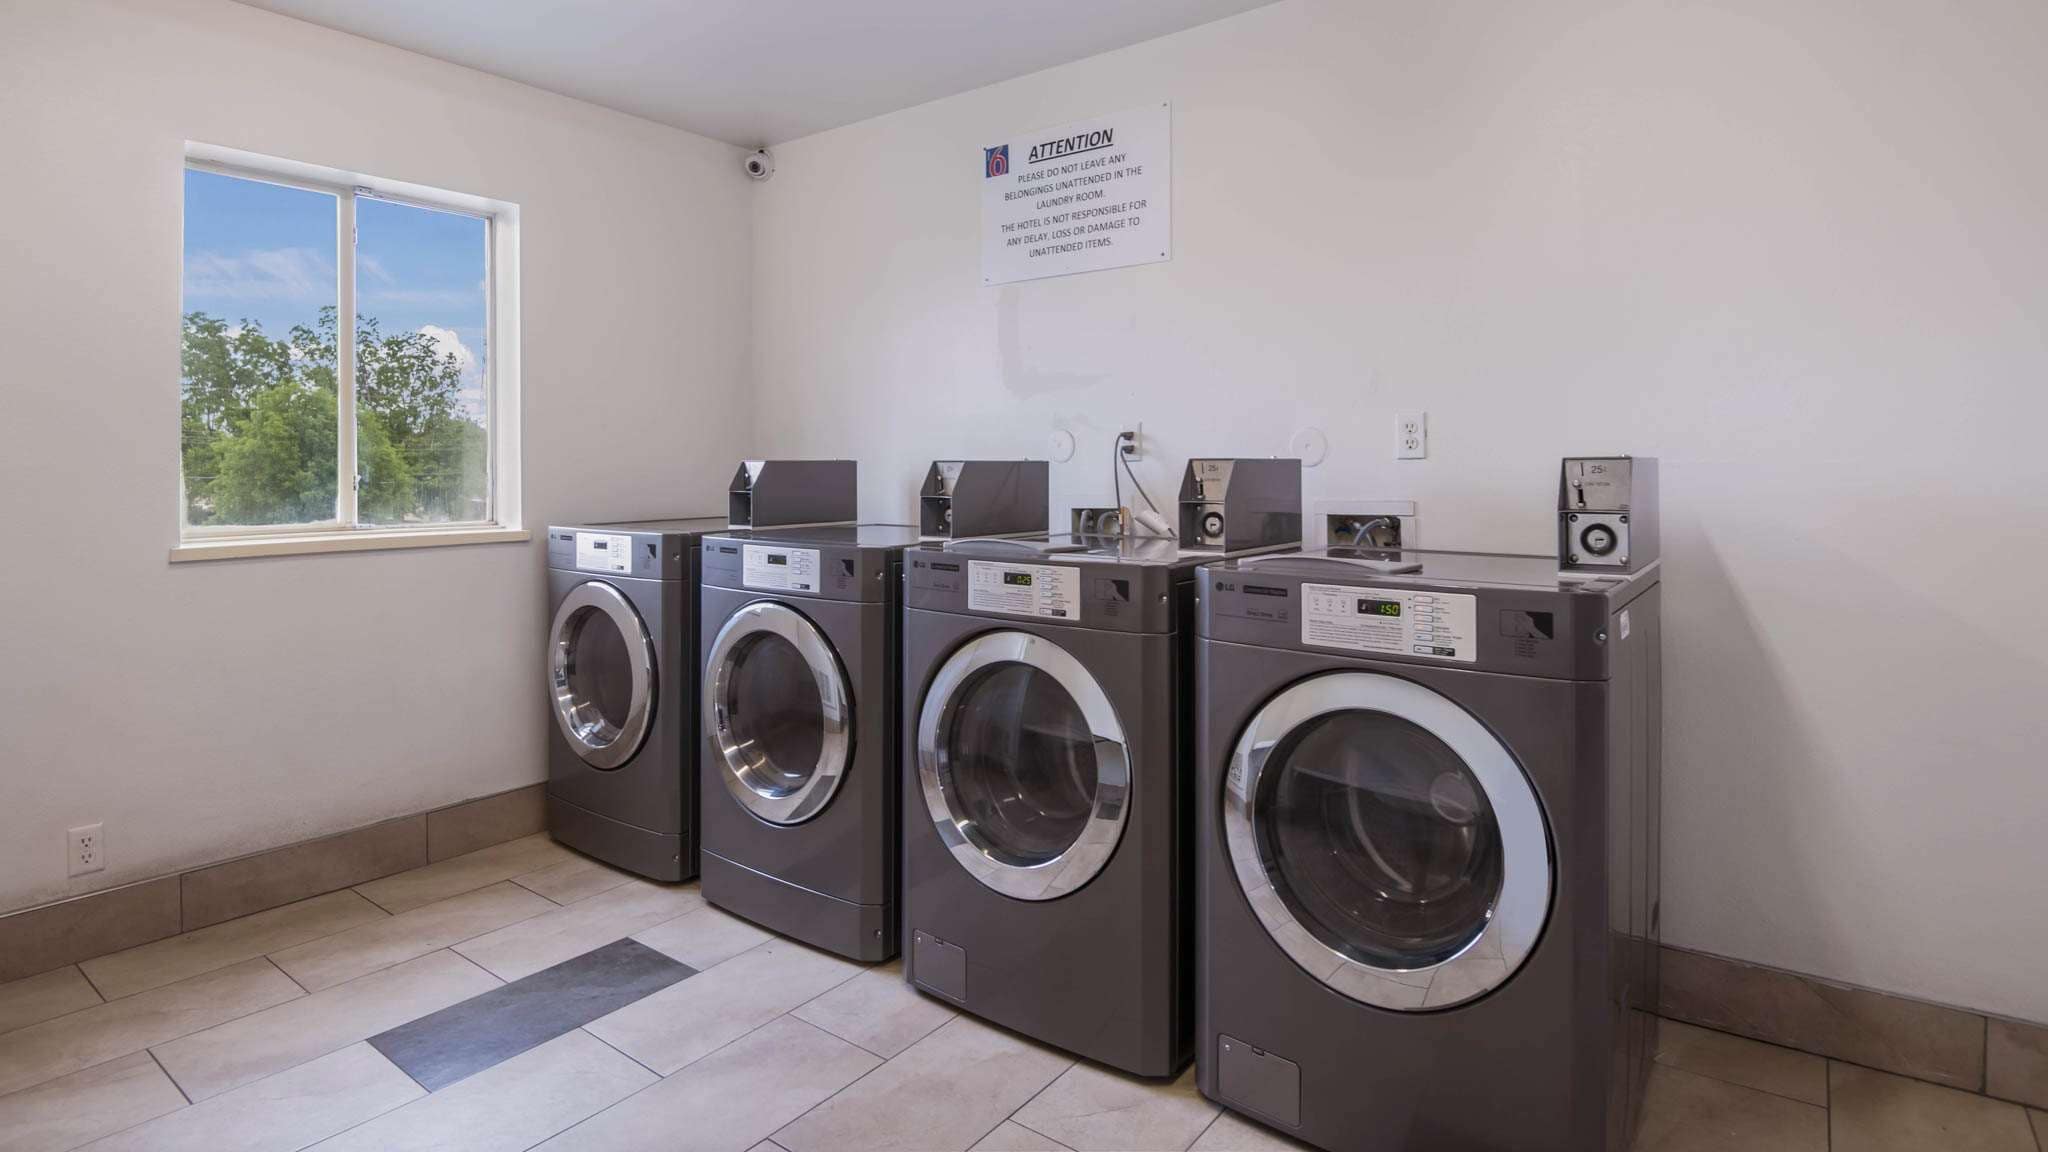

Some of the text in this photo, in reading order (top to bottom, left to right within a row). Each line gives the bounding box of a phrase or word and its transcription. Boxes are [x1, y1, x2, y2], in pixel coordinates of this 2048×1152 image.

[1028, 128, 1113, 162] ATTENTION
[989, 147, 1007, 177] 6
[1018, 153, 1127, 184] PLEASE DO NOT LEAVE ANY
[1004, 166, 1143, 201] BELONGINGS UNATTENDED IN THE
[1036, 189, 1105, 210] LAUNDRY ROOM.
[1001, 199, 1147, 233] THE HOTEL IS NOT RESPONSIBLE FOR
[1007, 238, 1022, 247] ANY
[1052, 228, 1071, 239] LOSS
[1073, 225, 1085, 235] OR
[1087, 219, 1126, 233] DAMAGE
[1128, 217, 1140, 226] TO
[1029, 237, 1112, 258] UNATTENDED ITEMS.
